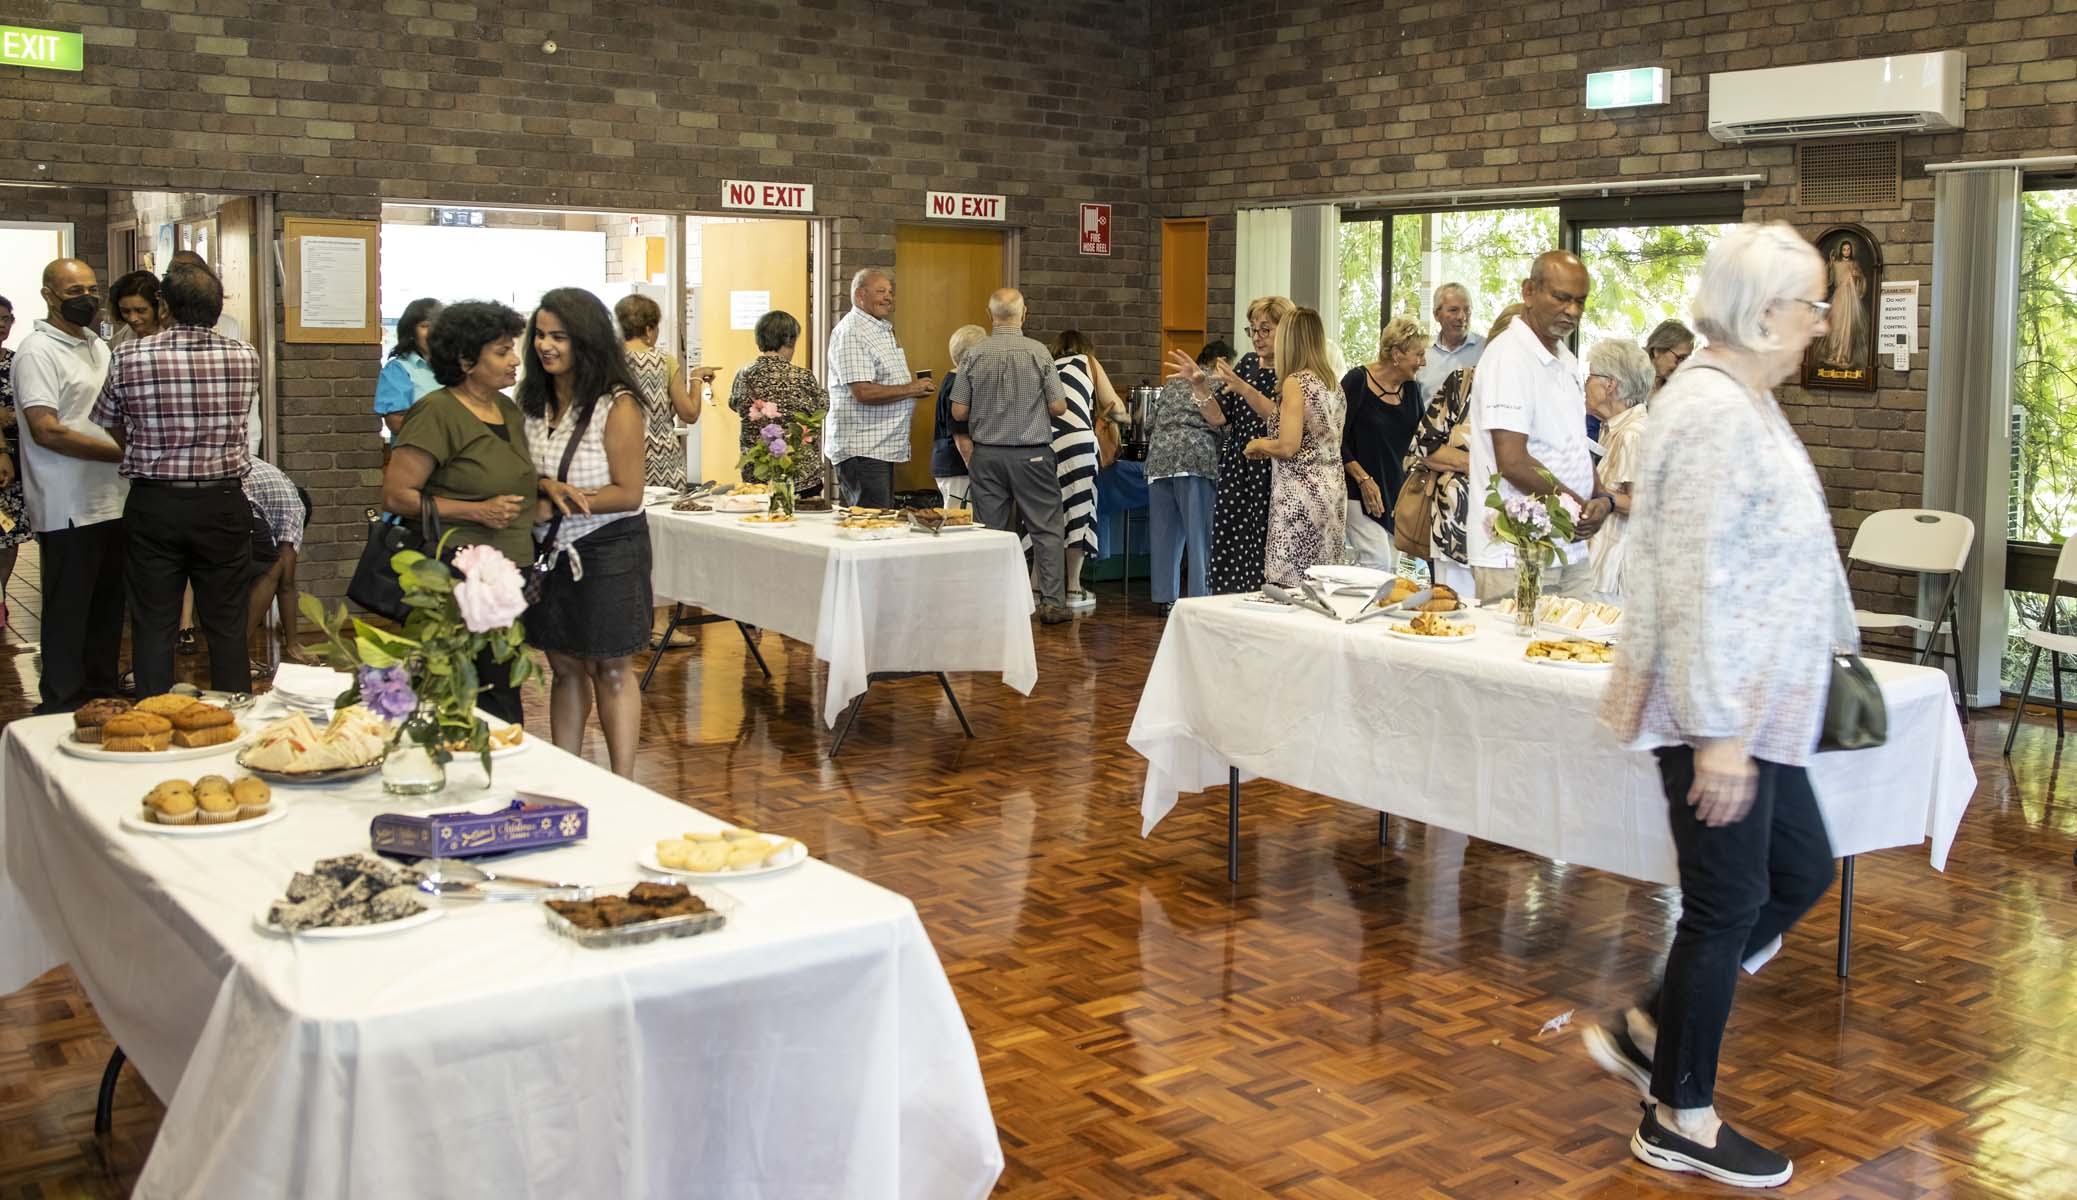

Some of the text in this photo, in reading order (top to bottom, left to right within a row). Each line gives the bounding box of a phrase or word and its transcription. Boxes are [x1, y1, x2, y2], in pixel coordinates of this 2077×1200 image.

[4, 31, 60, 62] EXIT
[730, 184, 805, 208] NO EXIT
[933, 195, 999, 217] NO EXIT
[1083, 242, 1107, 252] HOSE REEL
[1090, 233, 1101, 243] FIRE
